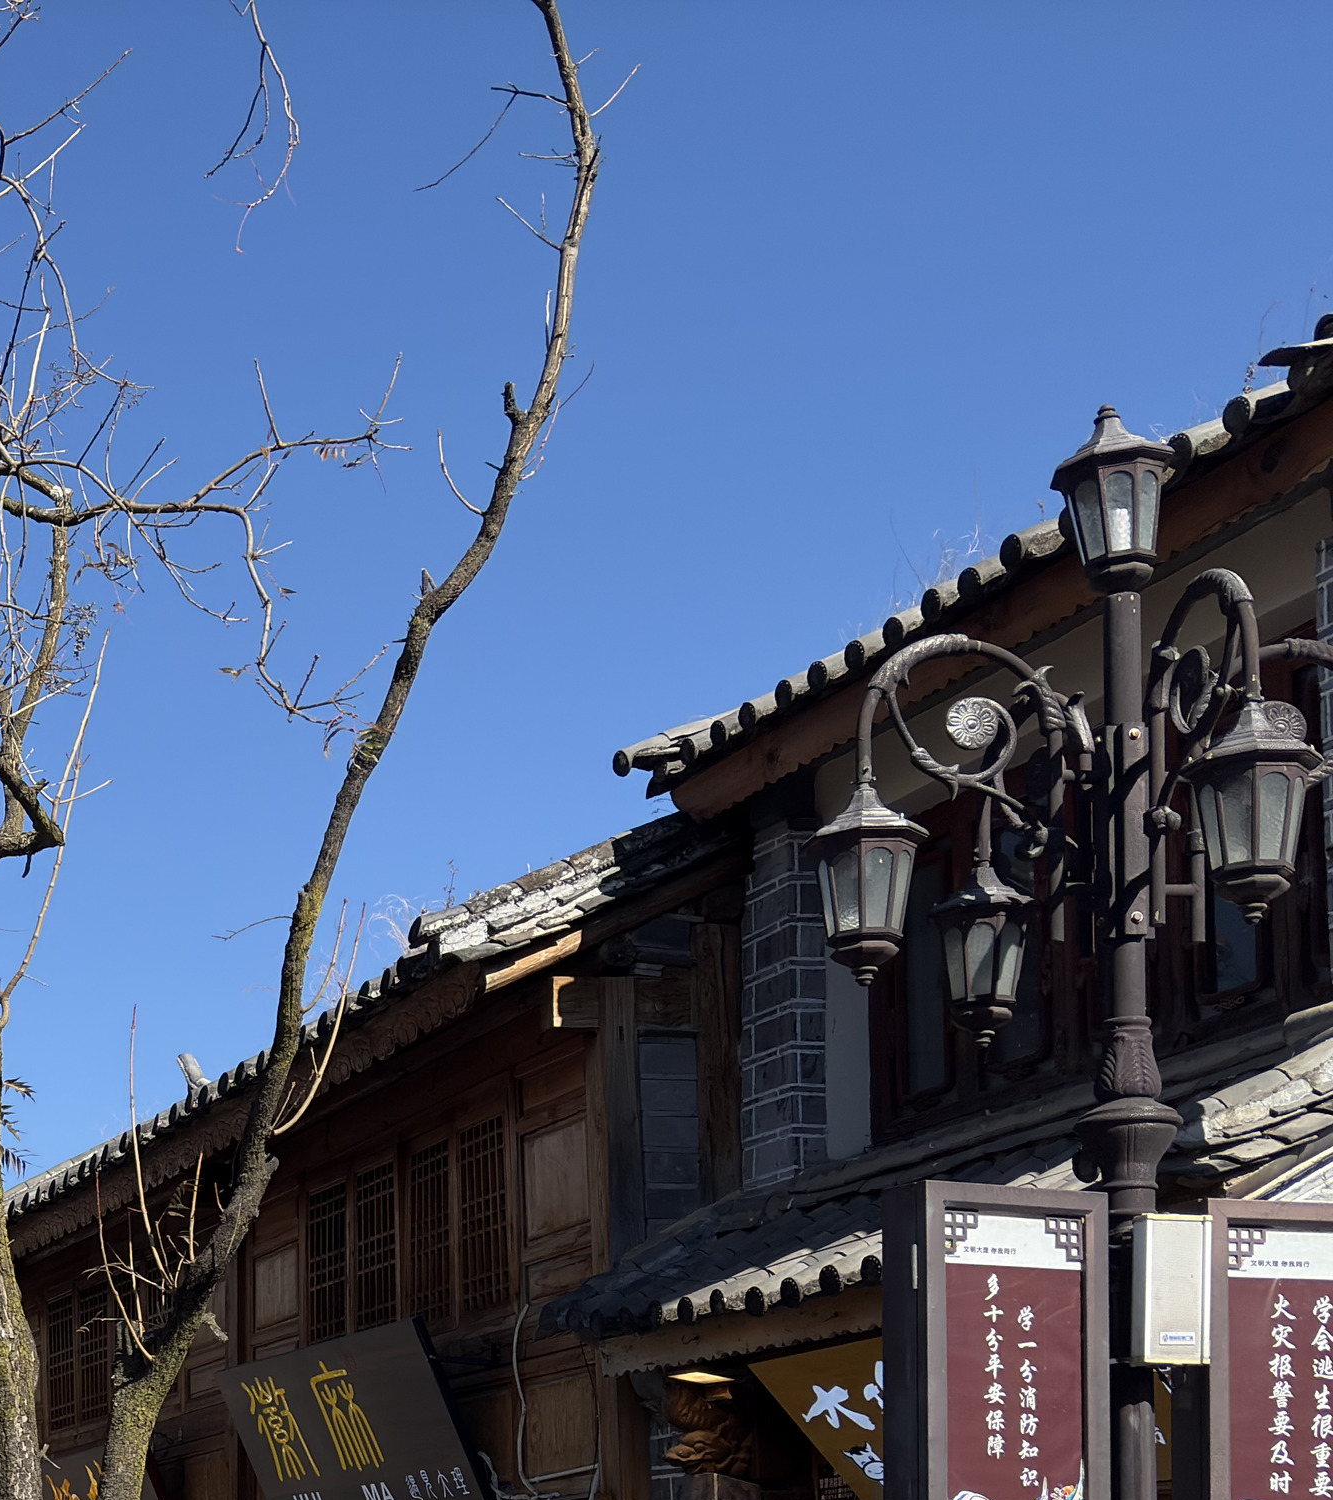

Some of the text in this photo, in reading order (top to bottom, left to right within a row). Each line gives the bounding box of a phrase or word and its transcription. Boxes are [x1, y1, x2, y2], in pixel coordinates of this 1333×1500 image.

[984, 1273, 1006, 1460] 多十分平安保障
[1017, 1305, 1039, 1487] 学一分消防知识
[1268, 1294, 1297, 1494] 火灾报警要及时
[1308, 1296, 1333, 1498] 学会逃生很重要
